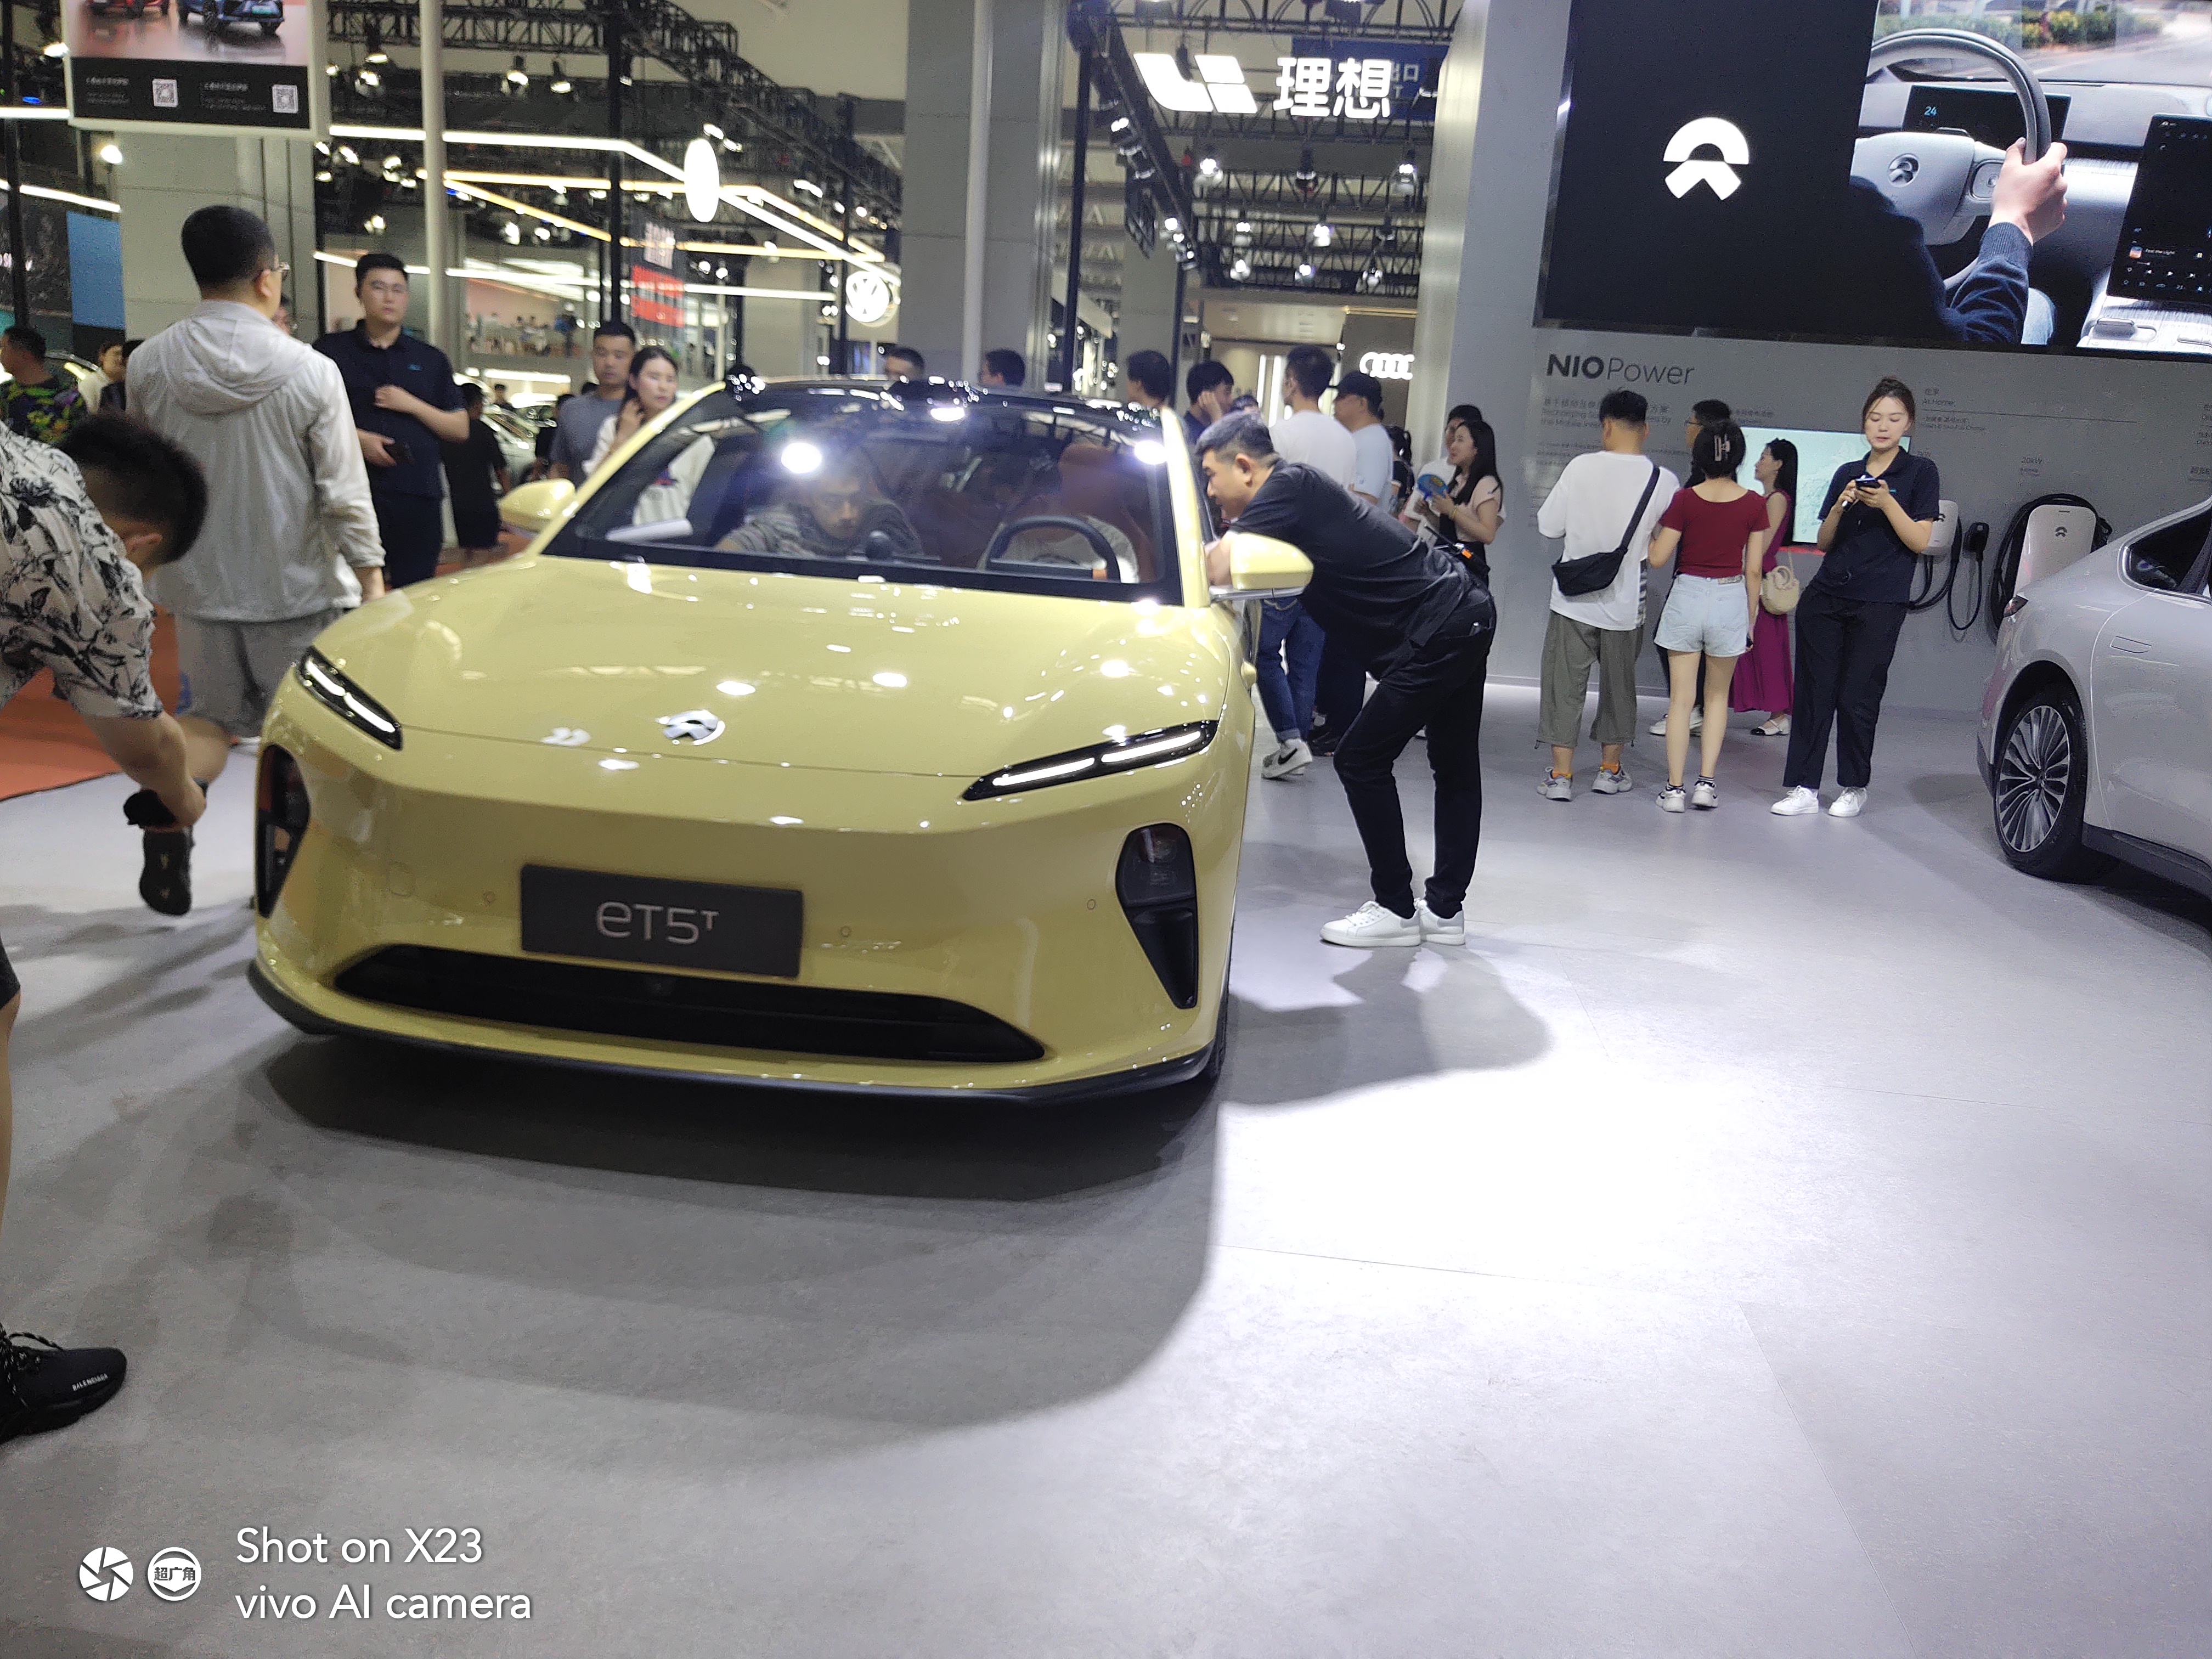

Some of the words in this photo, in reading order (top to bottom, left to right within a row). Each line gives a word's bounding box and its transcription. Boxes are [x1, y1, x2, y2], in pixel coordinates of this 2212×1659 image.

[1273, 57, 1392, 119] 理想
[1924, 106, 1938, 116] 24
[72, 1373, 109, 1392] BALENCIAGA
